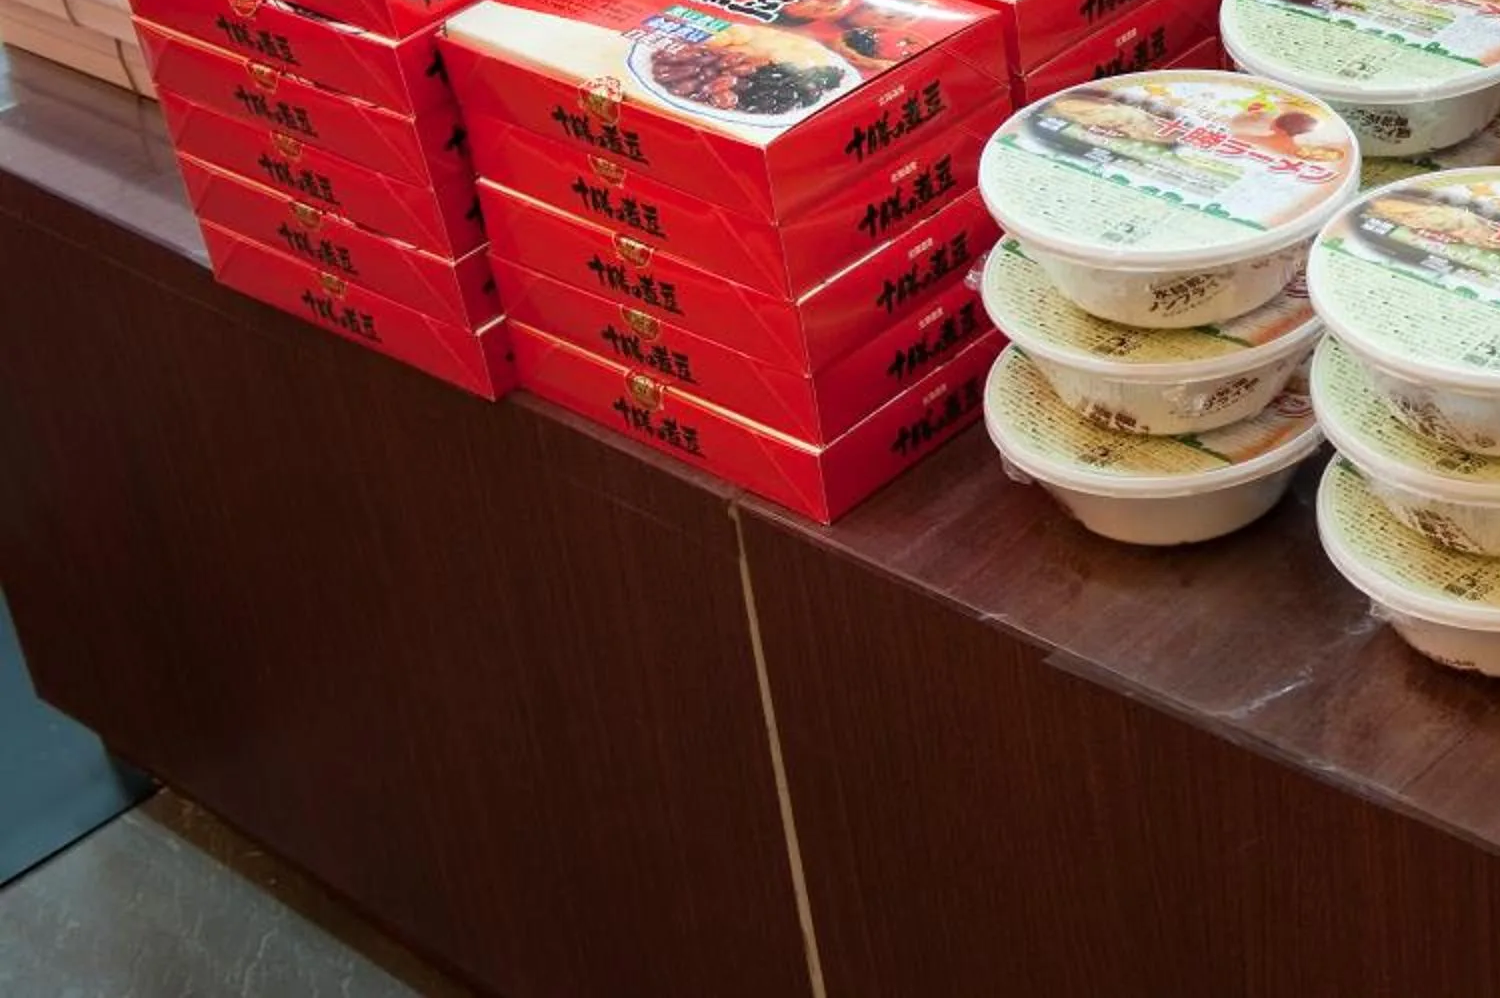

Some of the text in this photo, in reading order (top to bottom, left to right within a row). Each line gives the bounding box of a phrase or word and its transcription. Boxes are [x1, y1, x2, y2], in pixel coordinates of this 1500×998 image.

[1156, 118, 1338, 184] 十勝ラーメン
